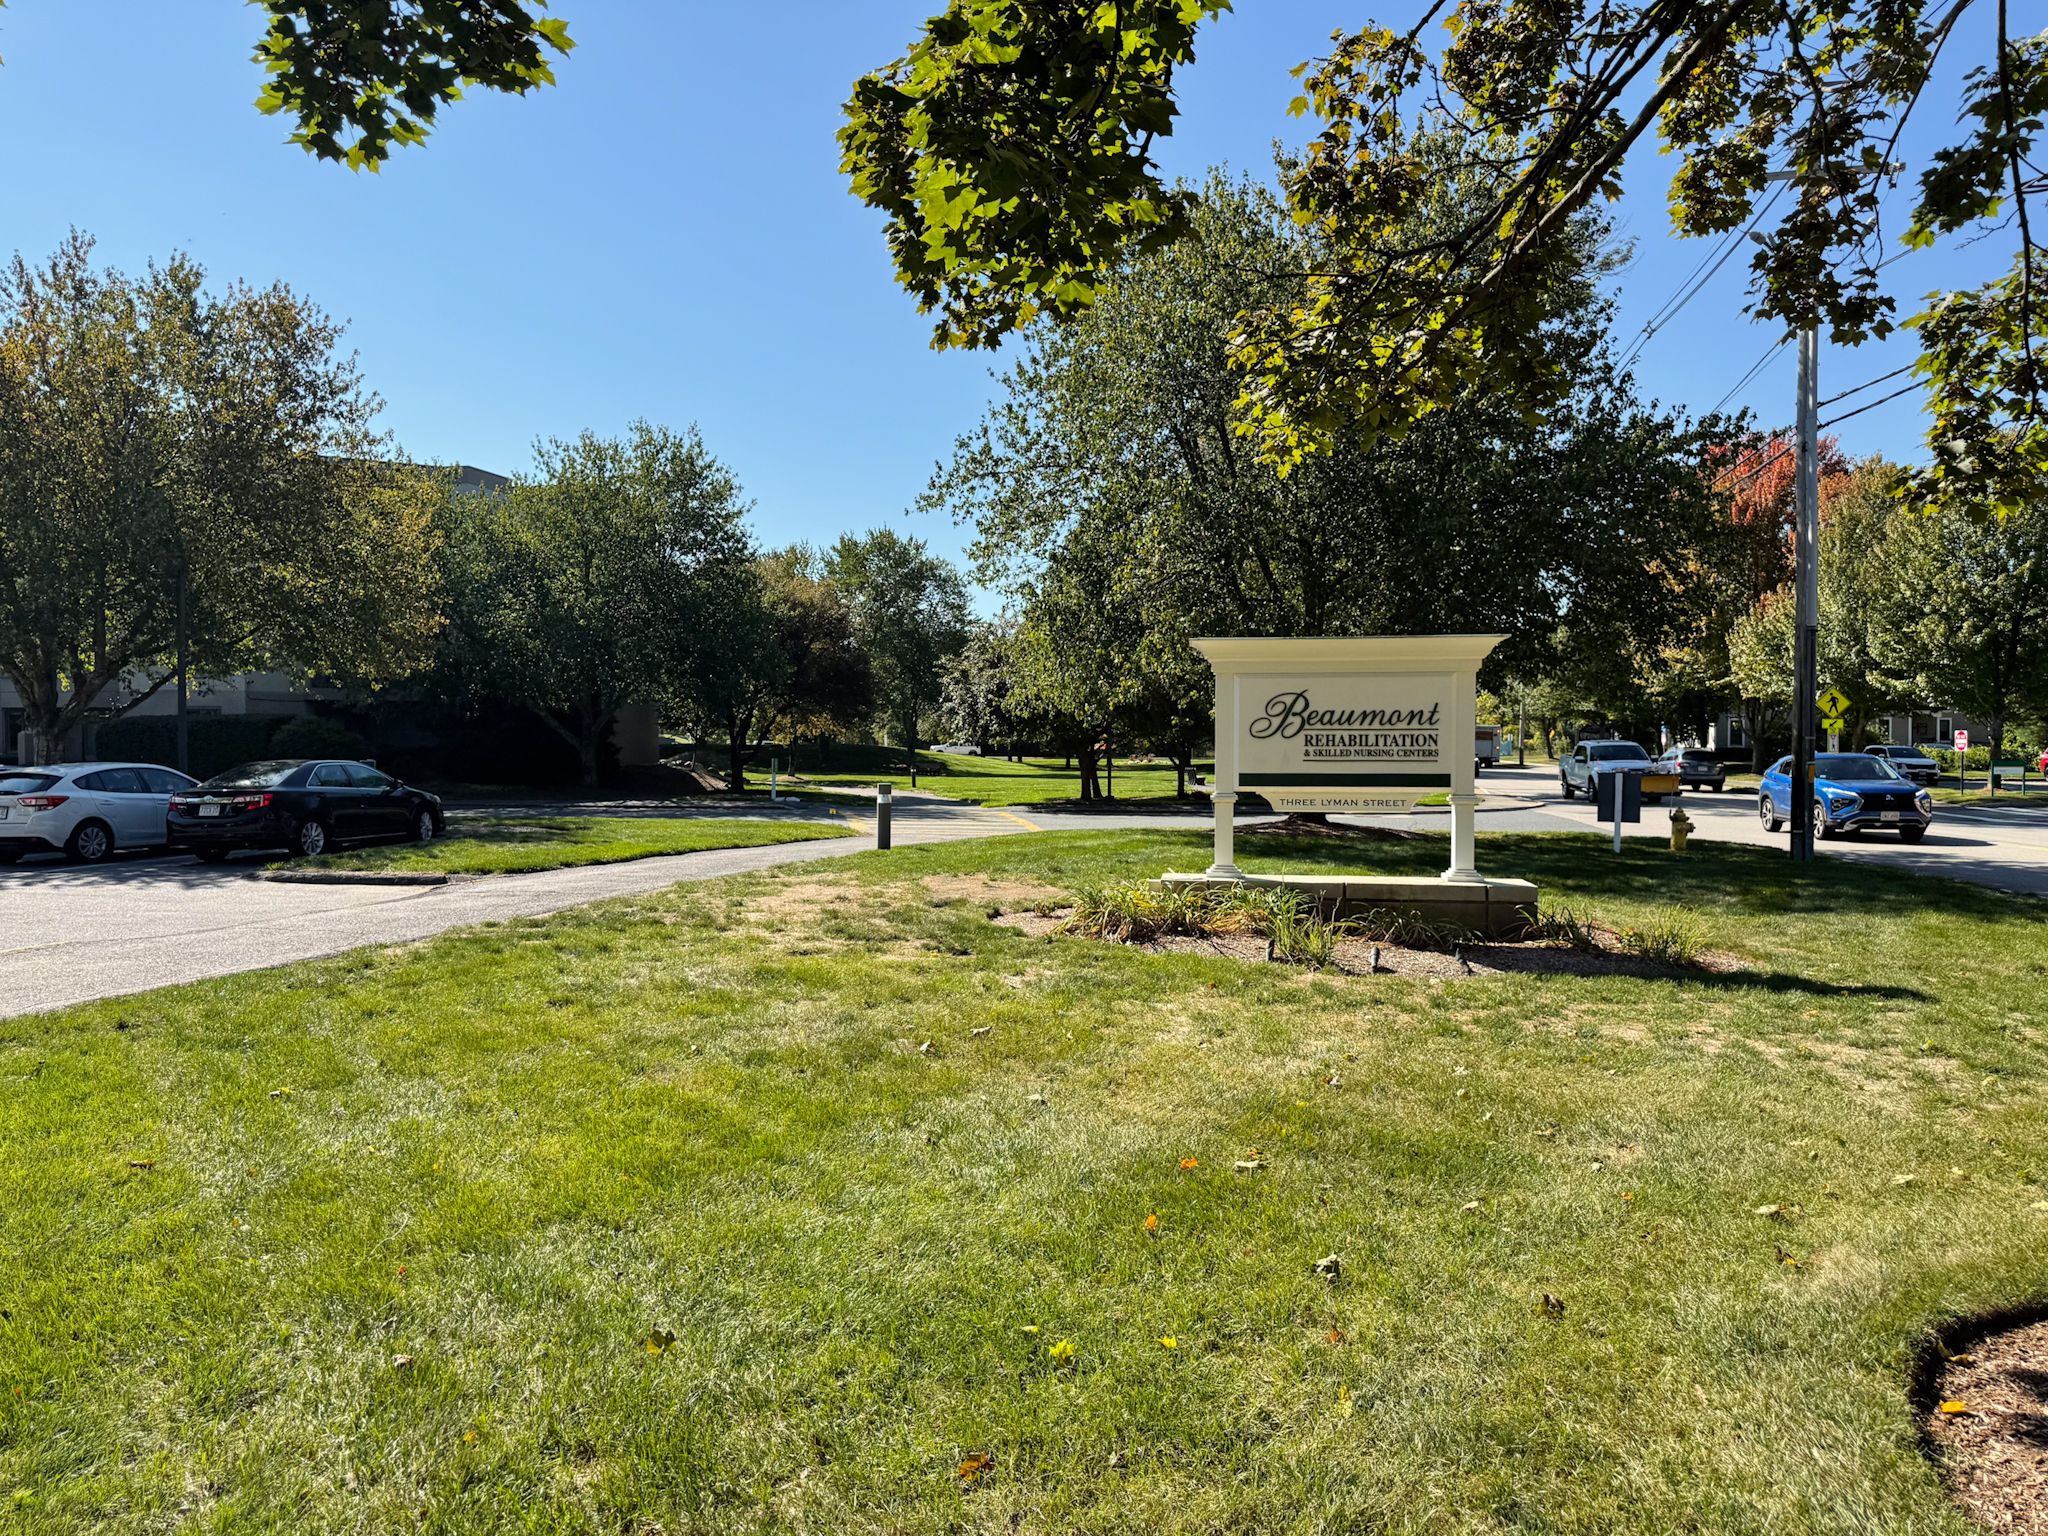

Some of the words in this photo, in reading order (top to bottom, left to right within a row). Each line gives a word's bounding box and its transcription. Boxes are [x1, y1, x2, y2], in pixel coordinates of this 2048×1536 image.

[1249, 689, 1440, 739] Beaumont
[1303, 733, 1439, 748] REHABILITATION
[1303, 749, 1310, 758] &
[1312, 749, 1352, 758] SKILLED
[1354, 749, 1394, 758] NURSING
[1396, 749, 1440, 758] CENTERS
[1280, 798, 1316, 807] THREE
[1321, 799, 1358, 807] LYMAN
[1363, 799, 1407, 807] STREET
